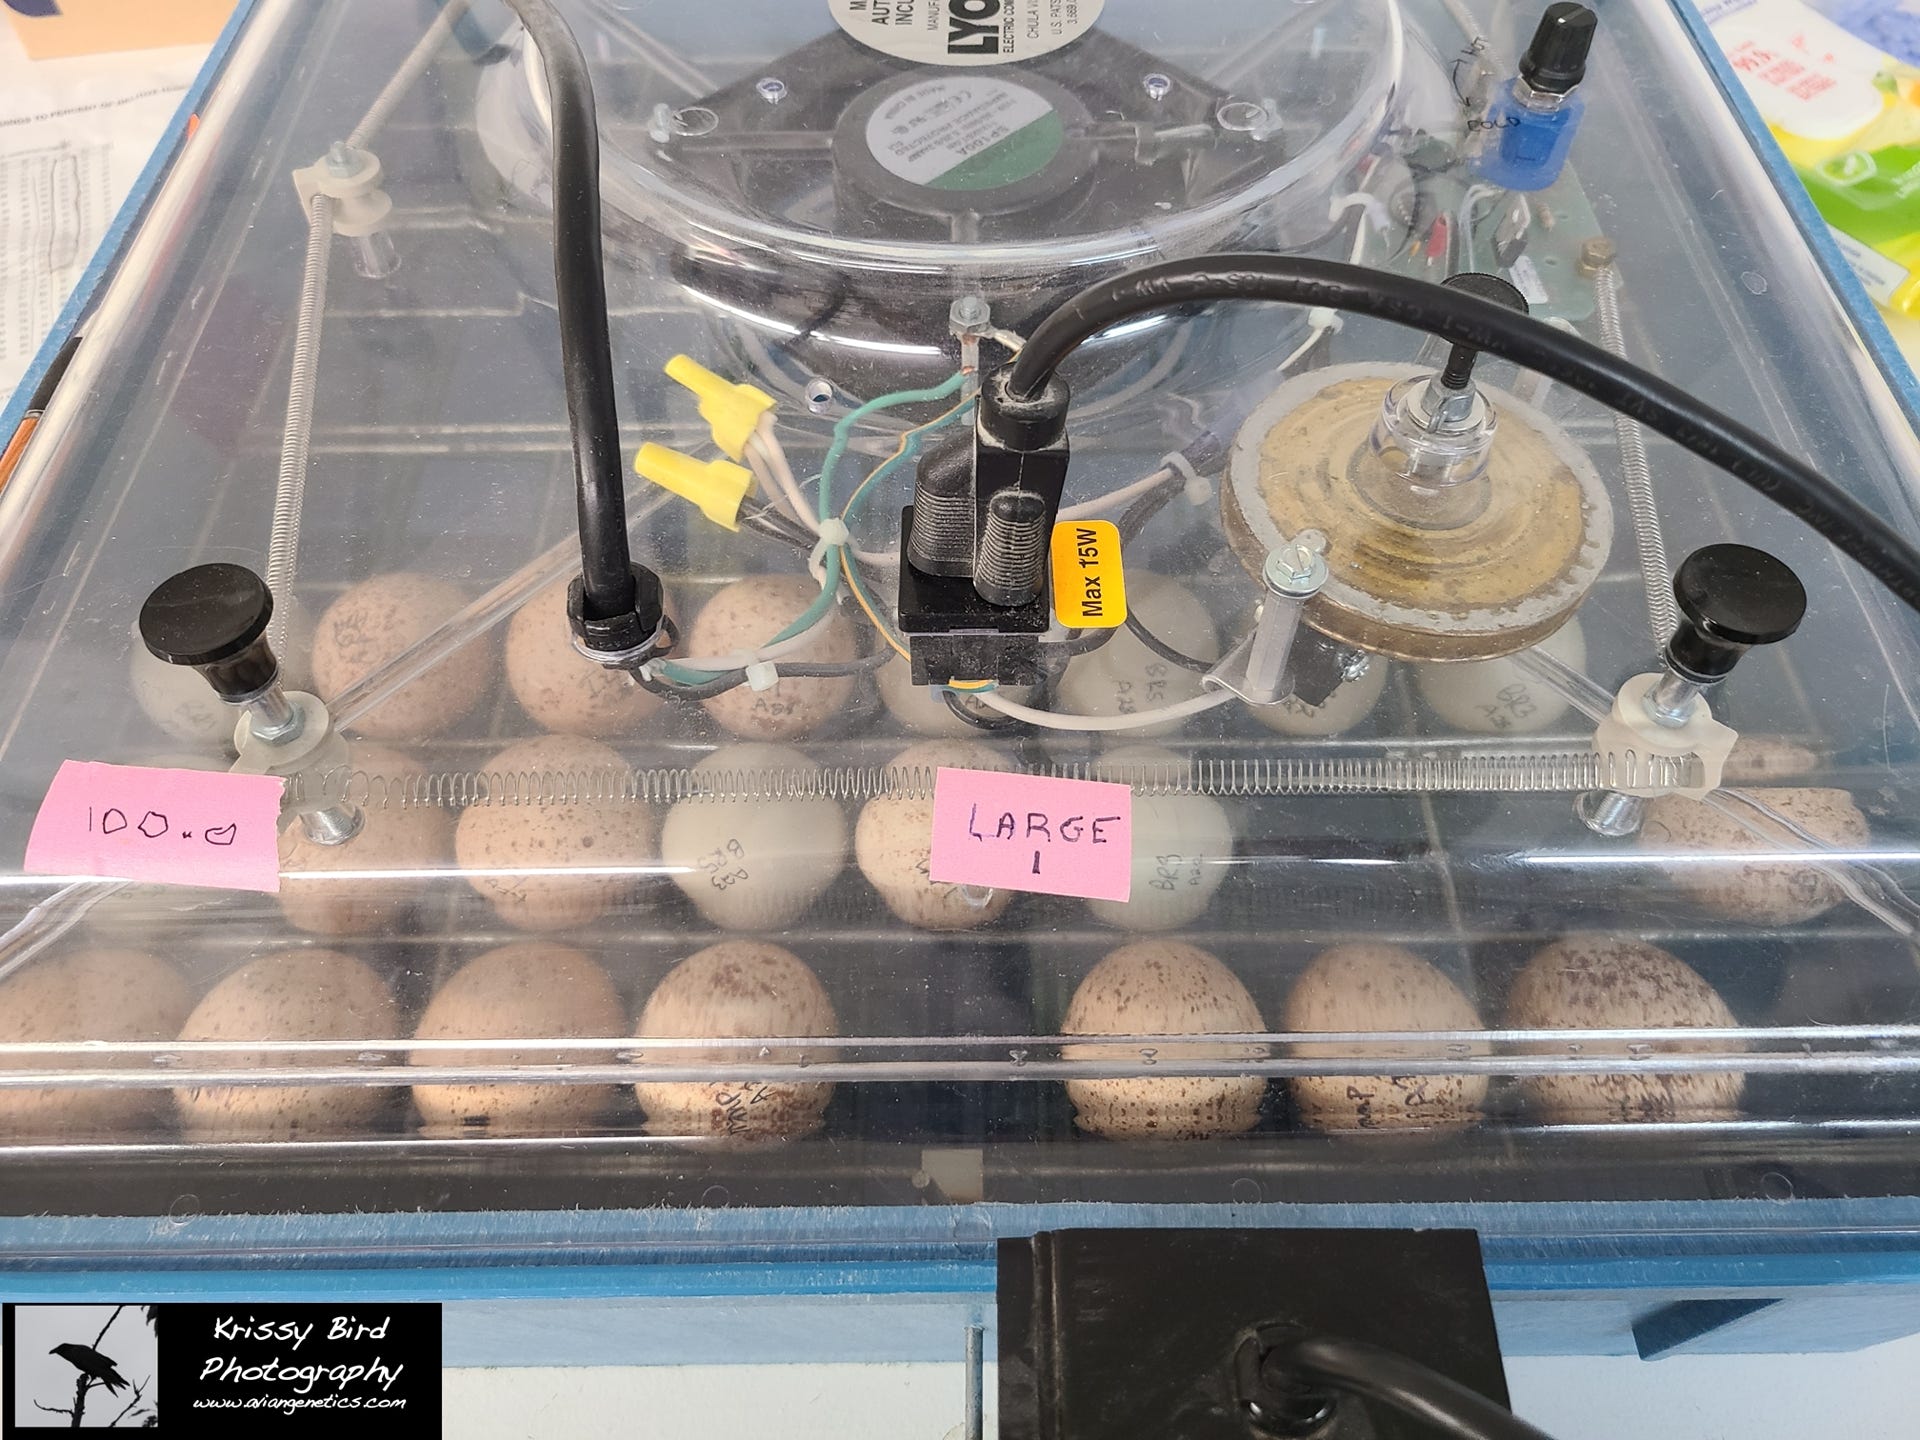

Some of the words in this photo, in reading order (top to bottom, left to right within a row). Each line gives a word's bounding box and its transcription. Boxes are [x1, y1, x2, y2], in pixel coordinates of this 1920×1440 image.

[850, 0, 867, 10] M
[927, 0, 940, 31] MANUF
[1003, 17, 1015, 53] ELECTRIC
[1026, 10, 1039, 39] CHULA
[1076, 528, 1099, 569] 15W
[1081, 576, 1103, 617] Max
[88, 805, 237, 846] 100.0
[968, 803, 1121, 844] LARGE
